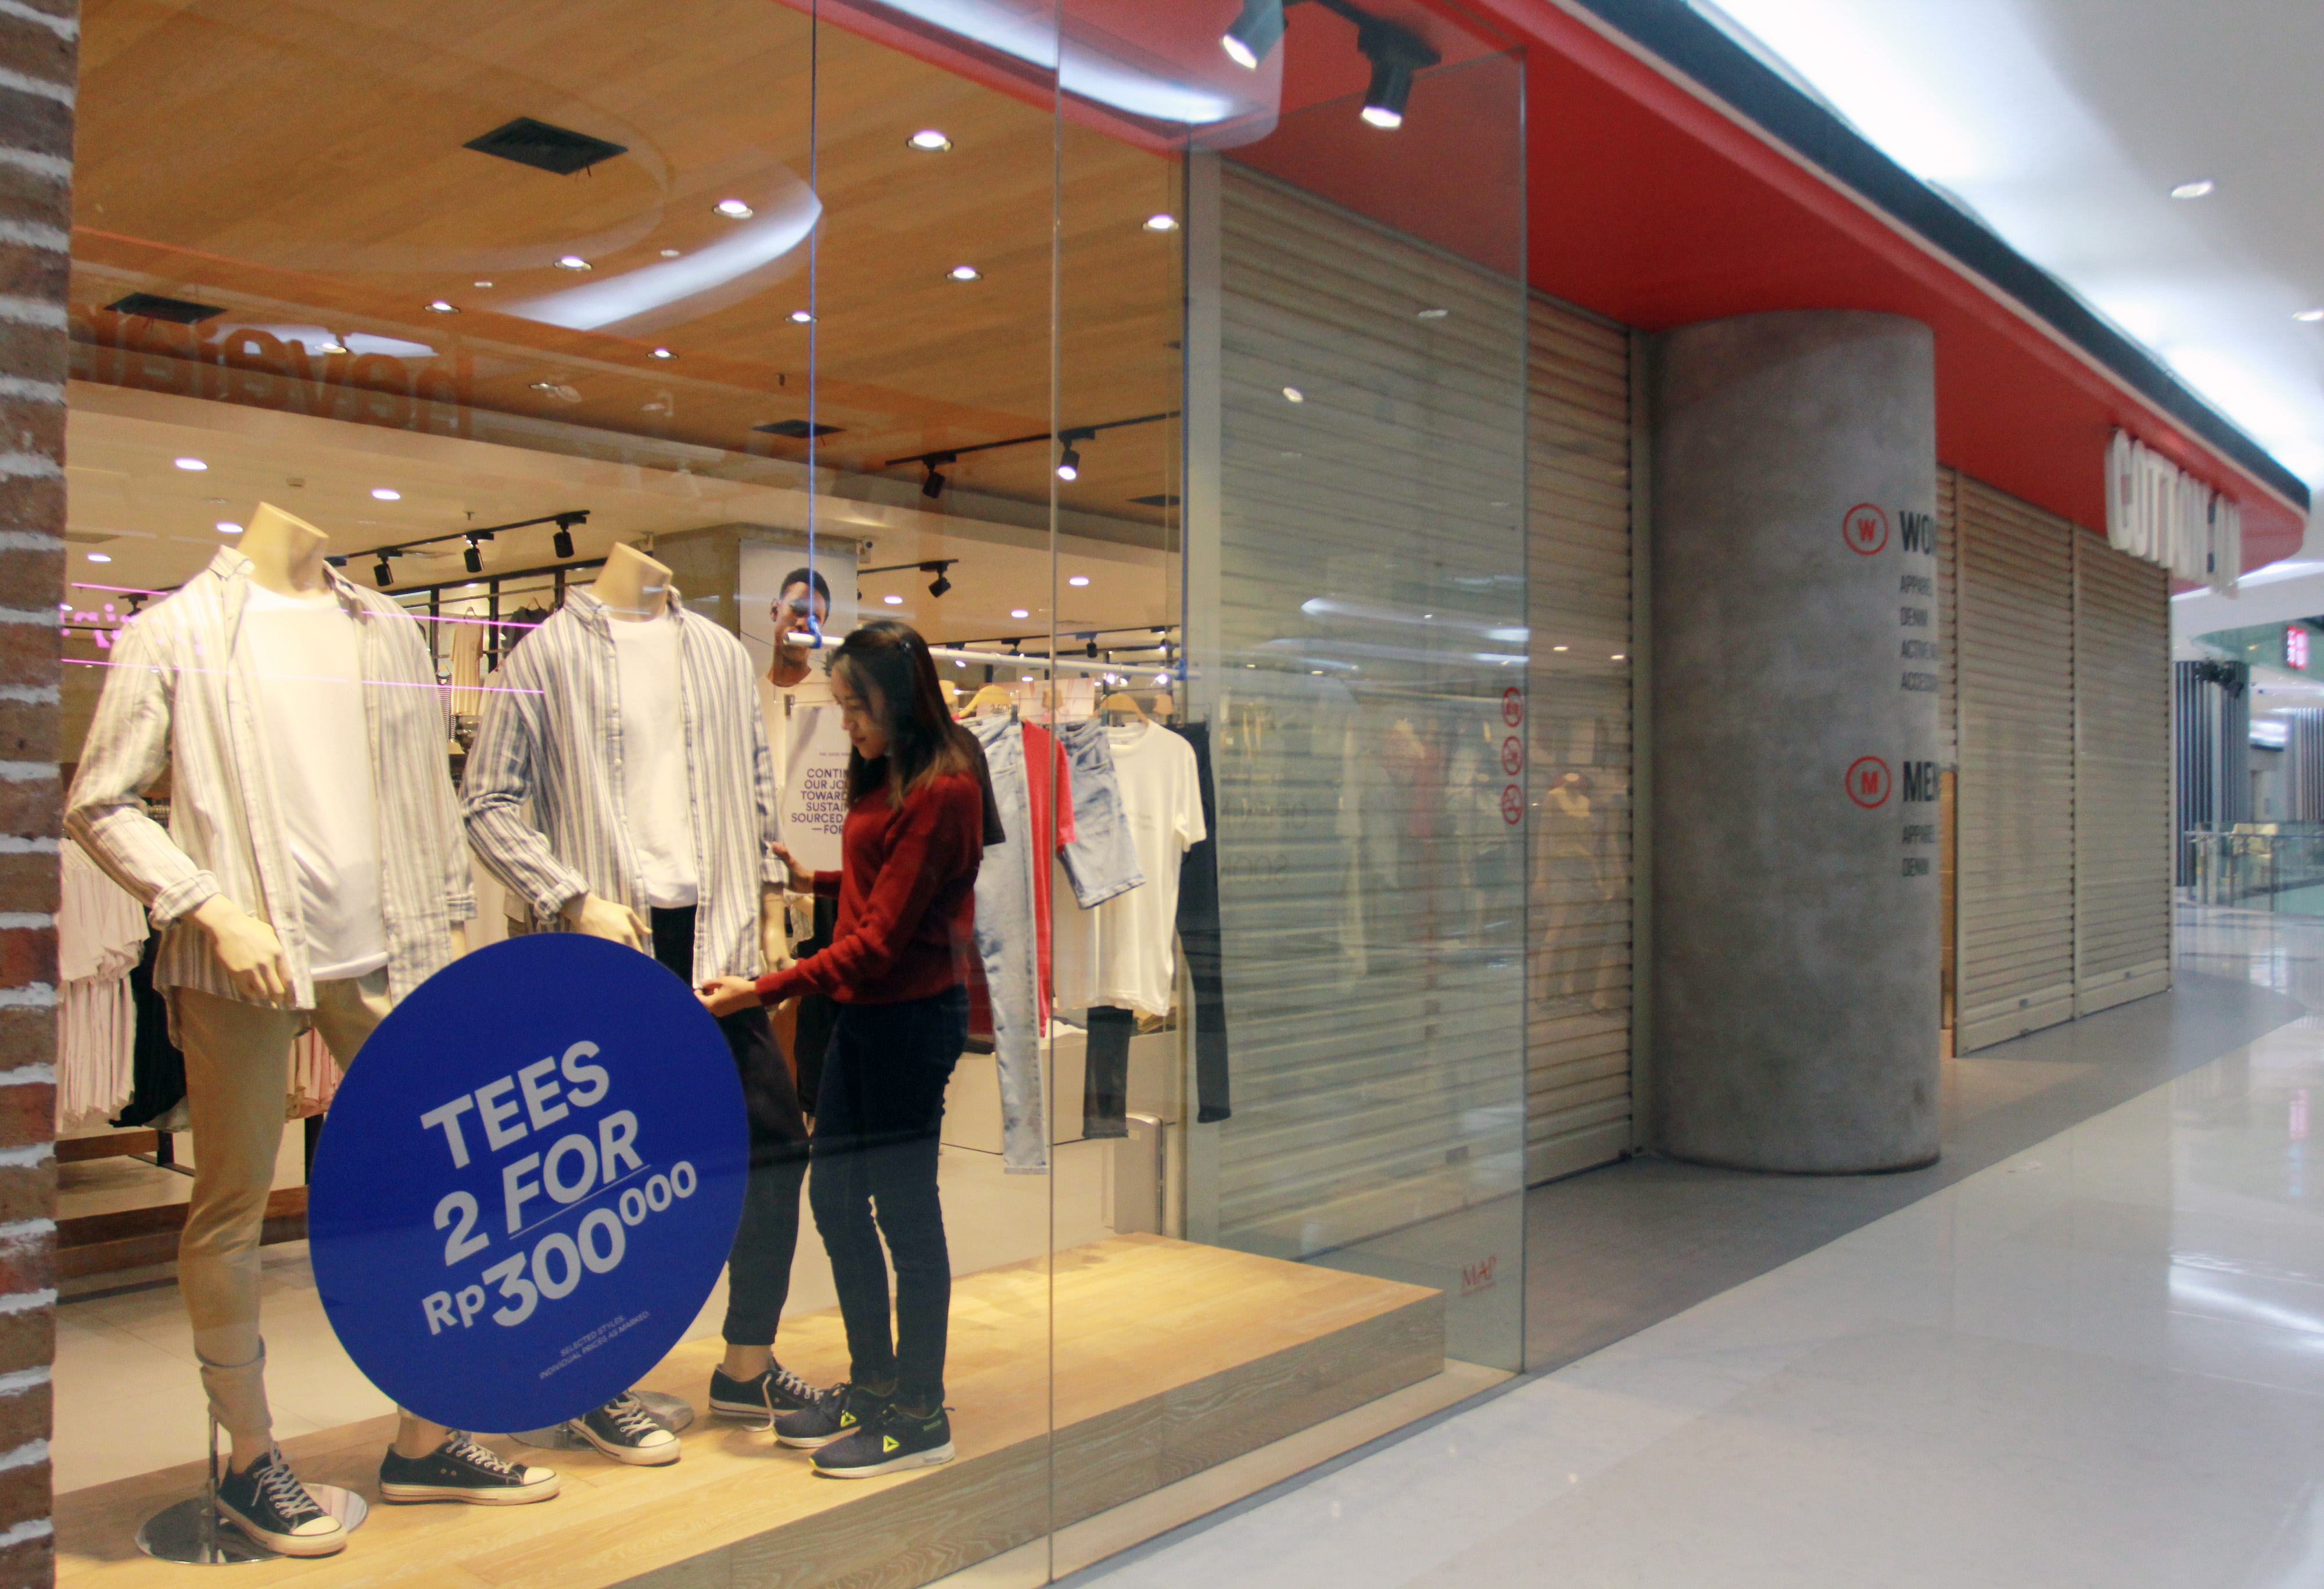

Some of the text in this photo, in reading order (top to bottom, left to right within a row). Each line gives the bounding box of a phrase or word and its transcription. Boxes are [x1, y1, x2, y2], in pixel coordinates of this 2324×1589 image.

[804, 780, 827, 789] OUR
[791, 813, 843, 823] SOURCED
[420, 1040, 610, 1169] TEES
[433, 1110, 644, 1267] 2 FOR
[539, 1351, 582, 1379] INDIVIDUAL
[582, 1335, 608, 1354] PRICES
[608, 1329, 619, 1339] AS
[560, 1330, 597, 1357] SELECTED
